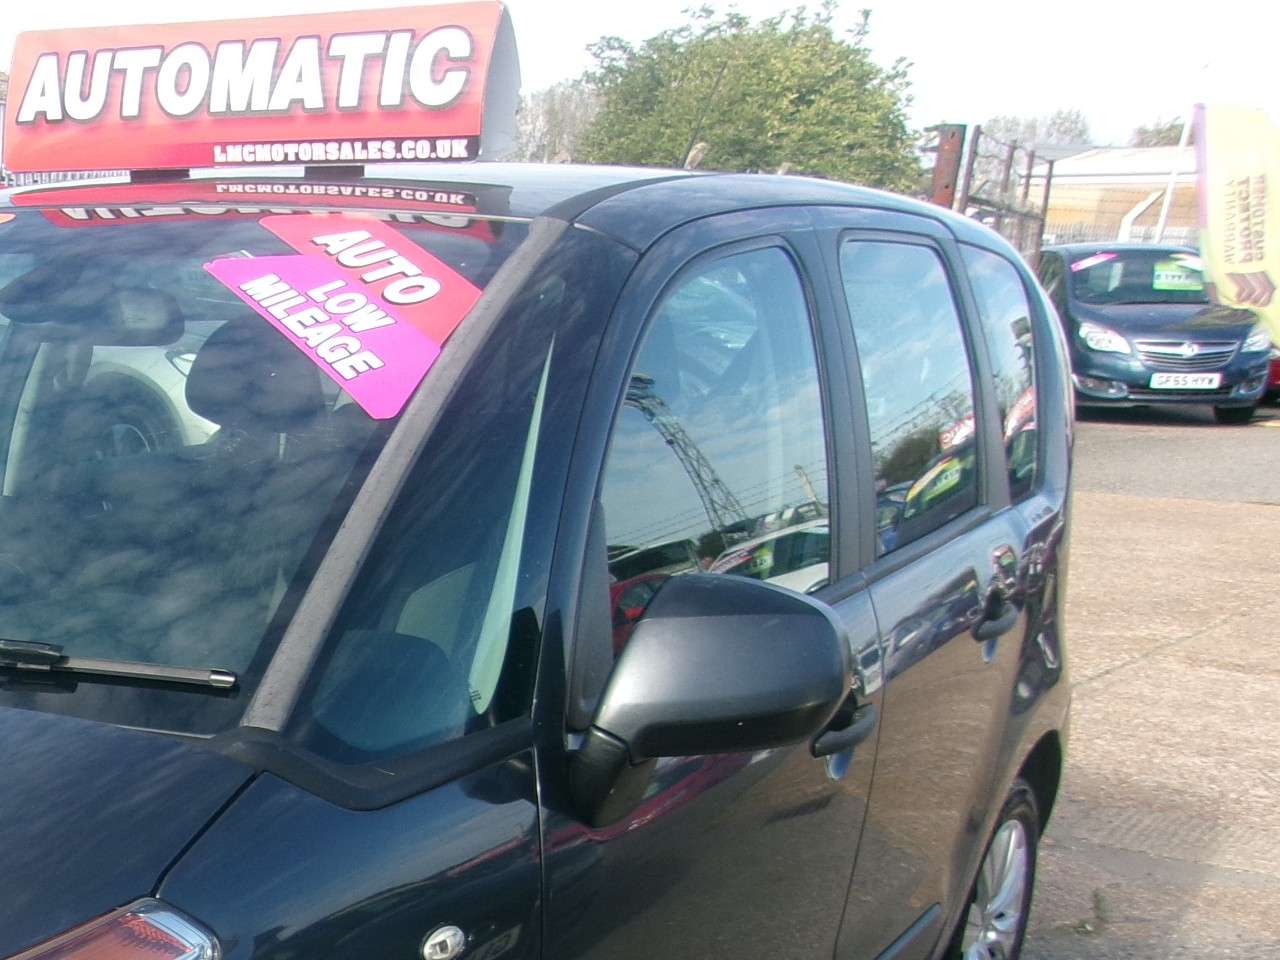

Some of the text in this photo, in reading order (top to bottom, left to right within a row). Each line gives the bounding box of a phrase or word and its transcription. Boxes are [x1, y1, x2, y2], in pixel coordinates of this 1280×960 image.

[16, 26, 472, 123] AUTOMATIC
[213, 139, 469, 163] LMCMOTORSALES.CO.UK
[312, 230, 441, 304] AUTO
[239, 273, 385, 381] MILEAGE
[306, 279, 398, 333] LOW
